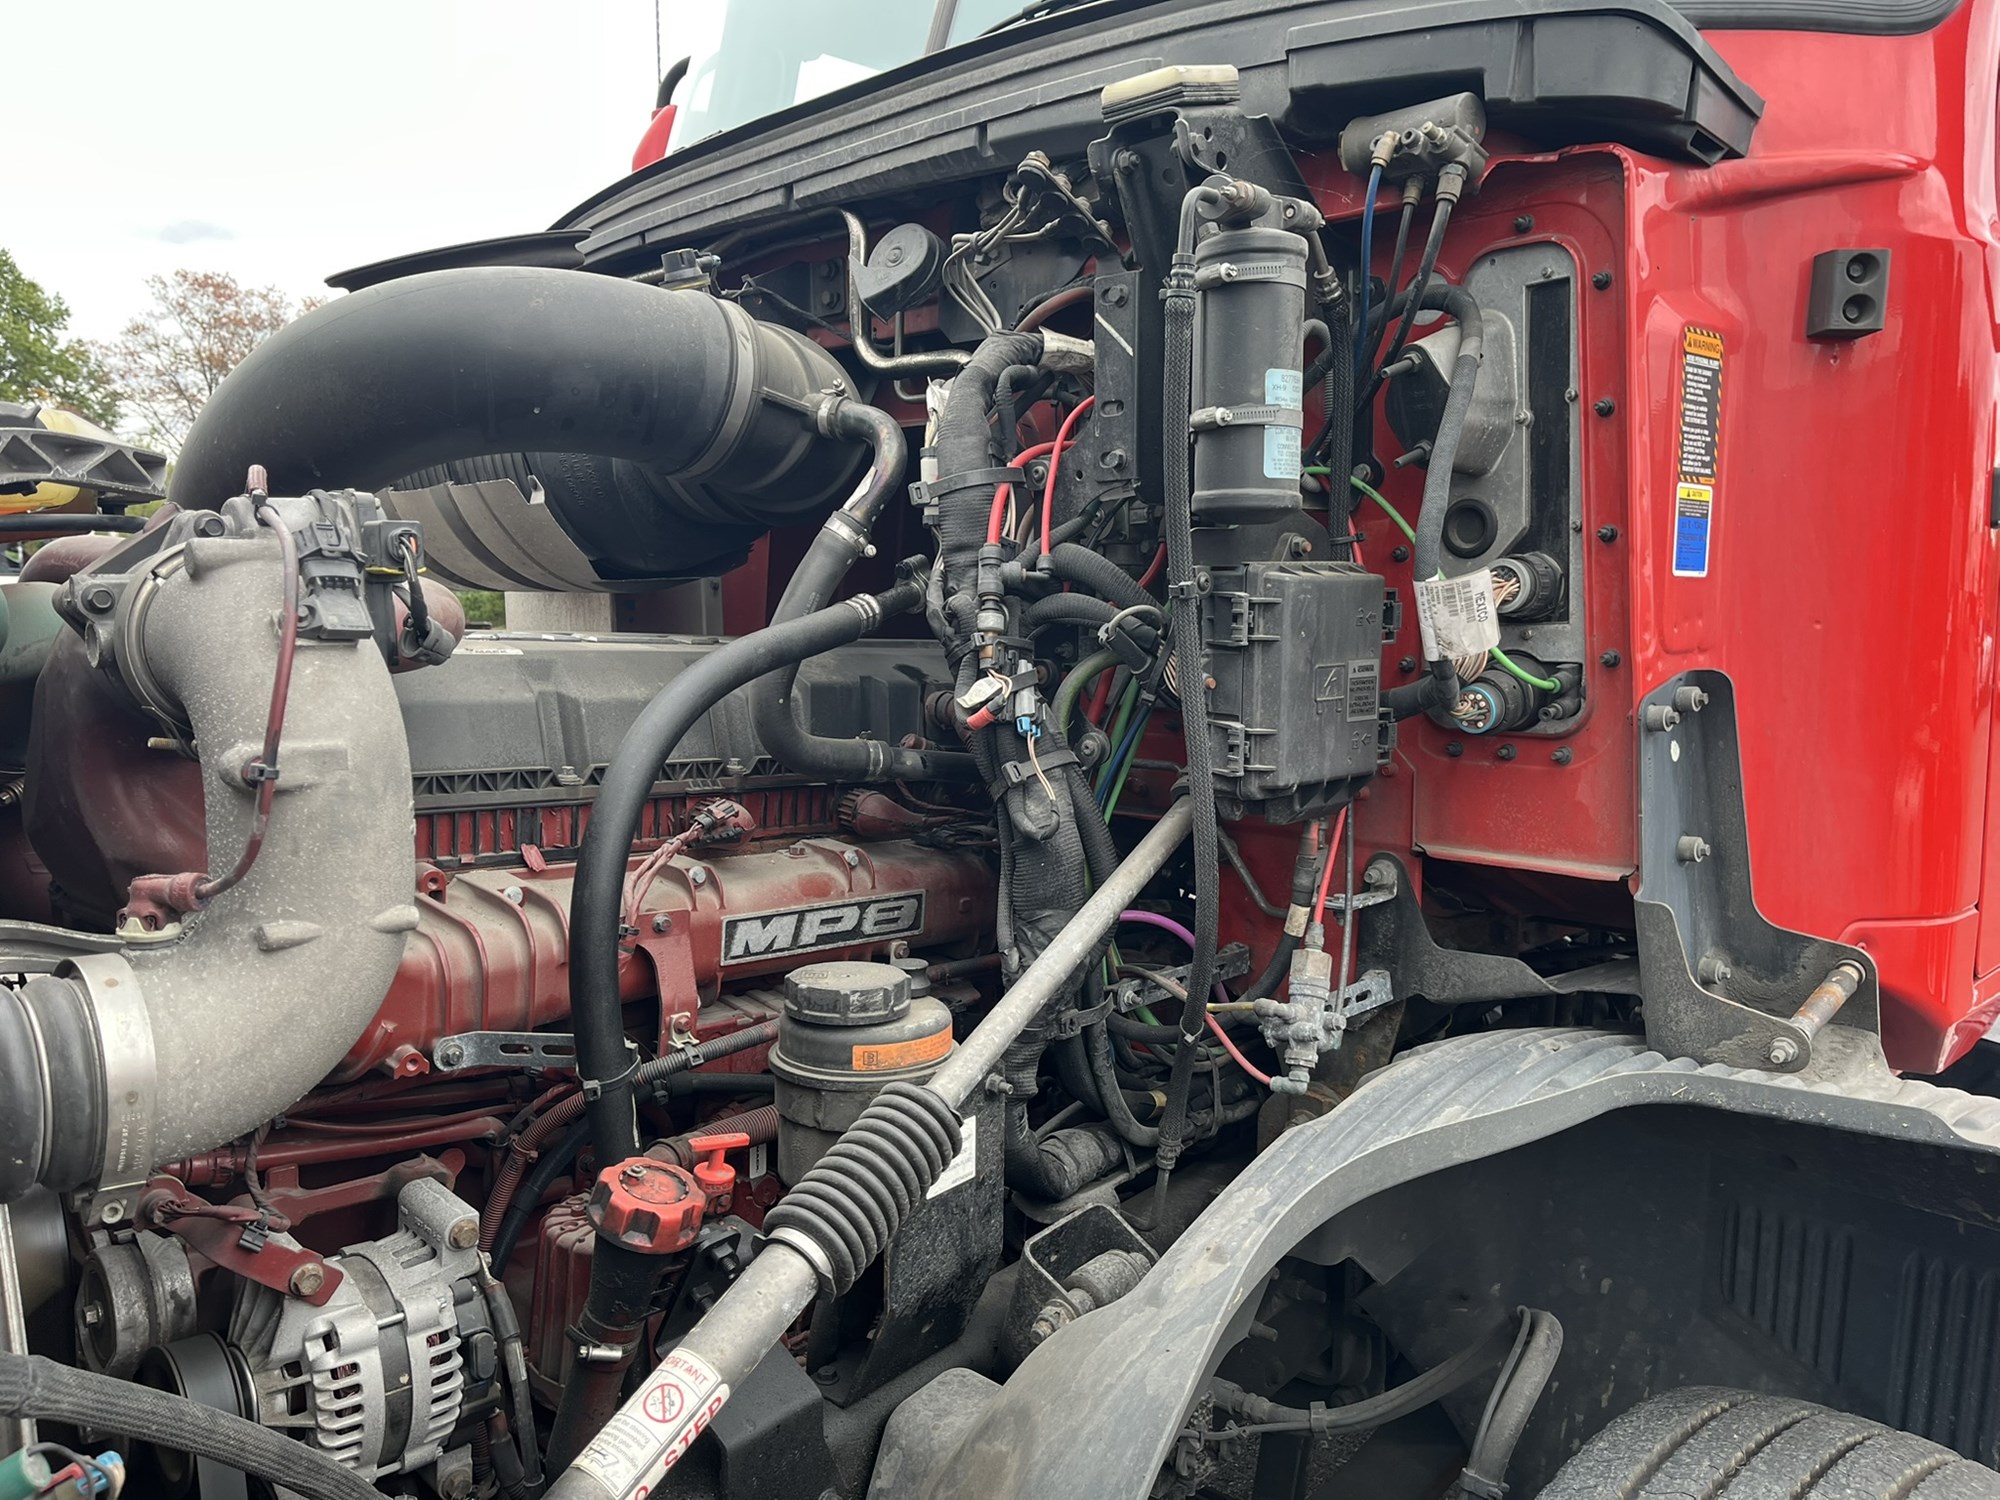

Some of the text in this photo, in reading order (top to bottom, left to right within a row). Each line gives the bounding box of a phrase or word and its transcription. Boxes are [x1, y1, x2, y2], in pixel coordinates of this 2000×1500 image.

[1692, 338, 1720, 354] WARNING
[1474, 590, 1489, 623] MEXICO
[728, 897, 919, 958] MP8
[664, 1355, 709, 1385] ORTANT
[664, 1396, 722, 1467] STEP
